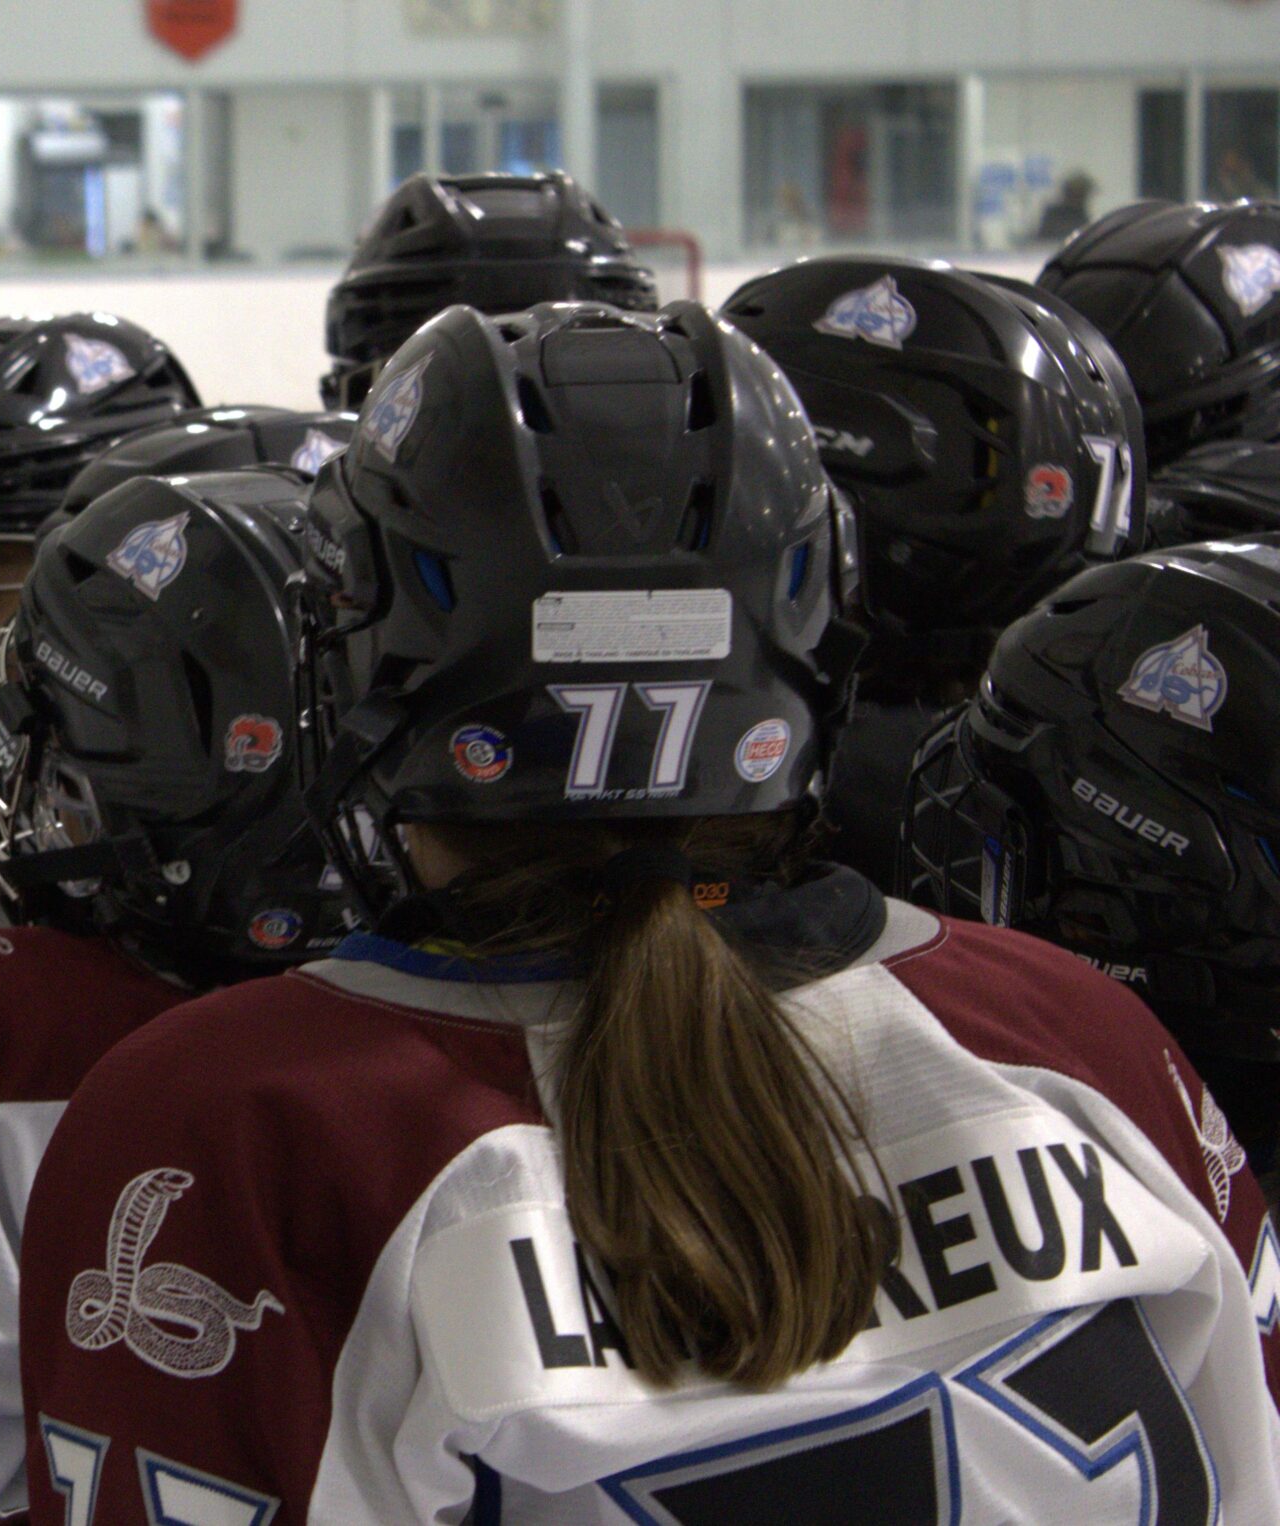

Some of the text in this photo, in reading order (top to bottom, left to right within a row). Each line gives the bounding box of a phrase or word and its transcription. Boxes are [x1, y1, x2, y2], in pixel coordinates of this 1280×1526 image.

[36, 641, 108, 701] BAUER
[546, 680, 713, 797] 77
[1071, 777, 1192, 857] BAUER
[1075, 953, 1148, 984] AUER
